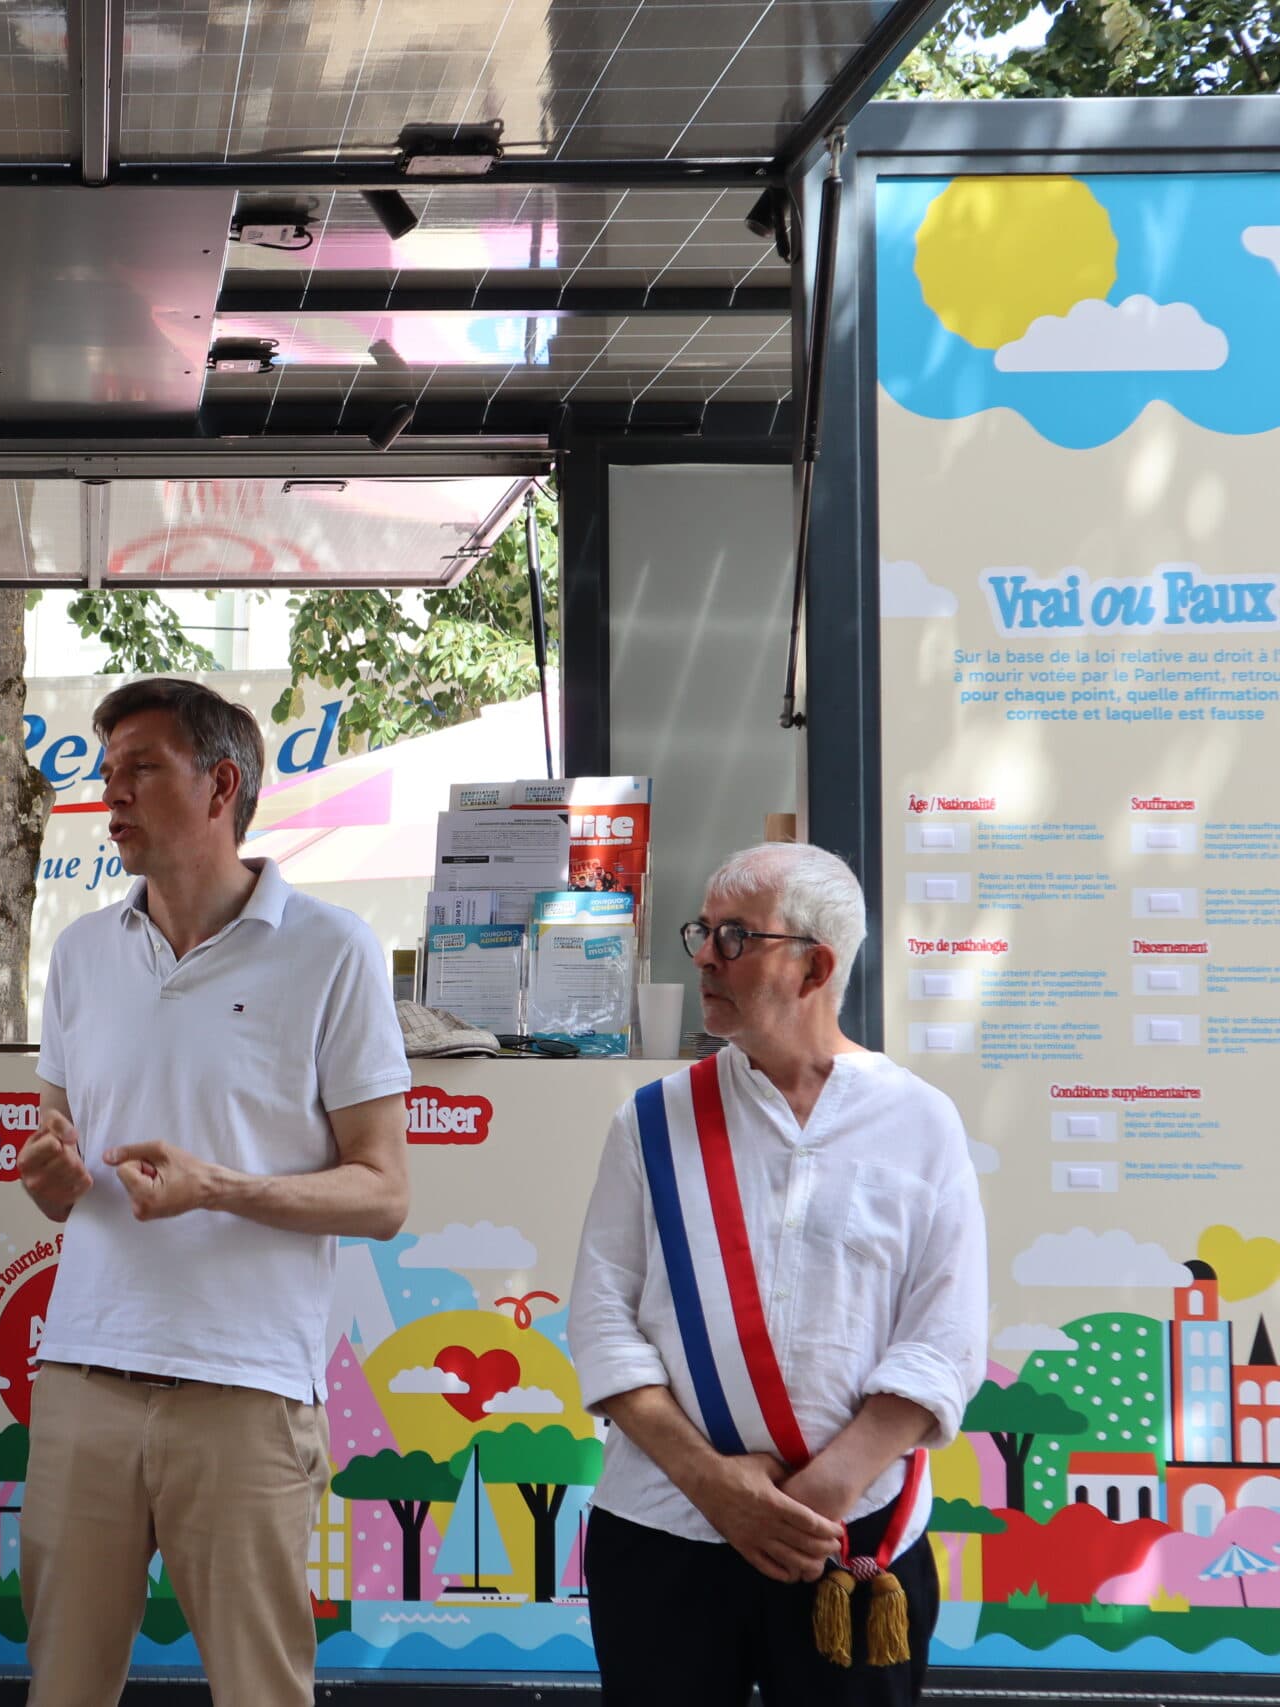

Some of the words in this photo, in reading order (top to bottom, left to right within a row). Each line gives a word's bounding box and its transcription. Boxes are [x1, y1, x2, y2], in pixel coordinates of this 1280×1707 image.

[988, 574, 1085, 629] Vrai
[1091, 586, 1157, 627] ou
[1163, 571, 1277, 625] Faux
[954, 649, 982, 664] Sur
[987, 649, 1001, 664] la
[1006, 649, 1045, 664] base
[1050, 649, 1071, 664] de
[1076, 649, 1090, 664] la
[1095, 649, 1116, 664] loi
[1121, 649, 1184, 663] relative
[1188, 651, 1209, 663] au
[1214, 649, 1253, 663] droit
[1258, 649, 1269, 663] à
[954, 668, 964, 683] à
[969, 668, 1023, 683] mourir
[1029, 668, 1076, 683] votée
[1081, 671, 1108, 684] par
[1114, 668, 1129, 682] le
[1135, 668, 1227, 683] Parlement,
[960, 690, 999, 704] pour
[1004, 687, 1066, 705] chaque
[1071, 687, 1121, 704] point,
[1127, 687, 1179, 704] quelle
[1184, 687, 1279, 701] affirmation
[1006, 708, 1078, 721] correcte
[1083, 708, 1101, 721] et
[1106, 706, 1173, 724] laquelle
[1178, 708, 1205, 721] est
[1211, 706, 1265, 721] fausse
[907, 794, 929, 813] Âge
[937, 797, 996, 811] Nationalité
[908, 938, 934, 954] Type
[936, 938, 950, 952] de
[951, 938, 1009, 955] pathologie
[1050, 1085, 1110, 1099] Conditions
[1111, 1085, 1202, 1102] supplémentaires
[404, 1097, 482, 1134] iliser
